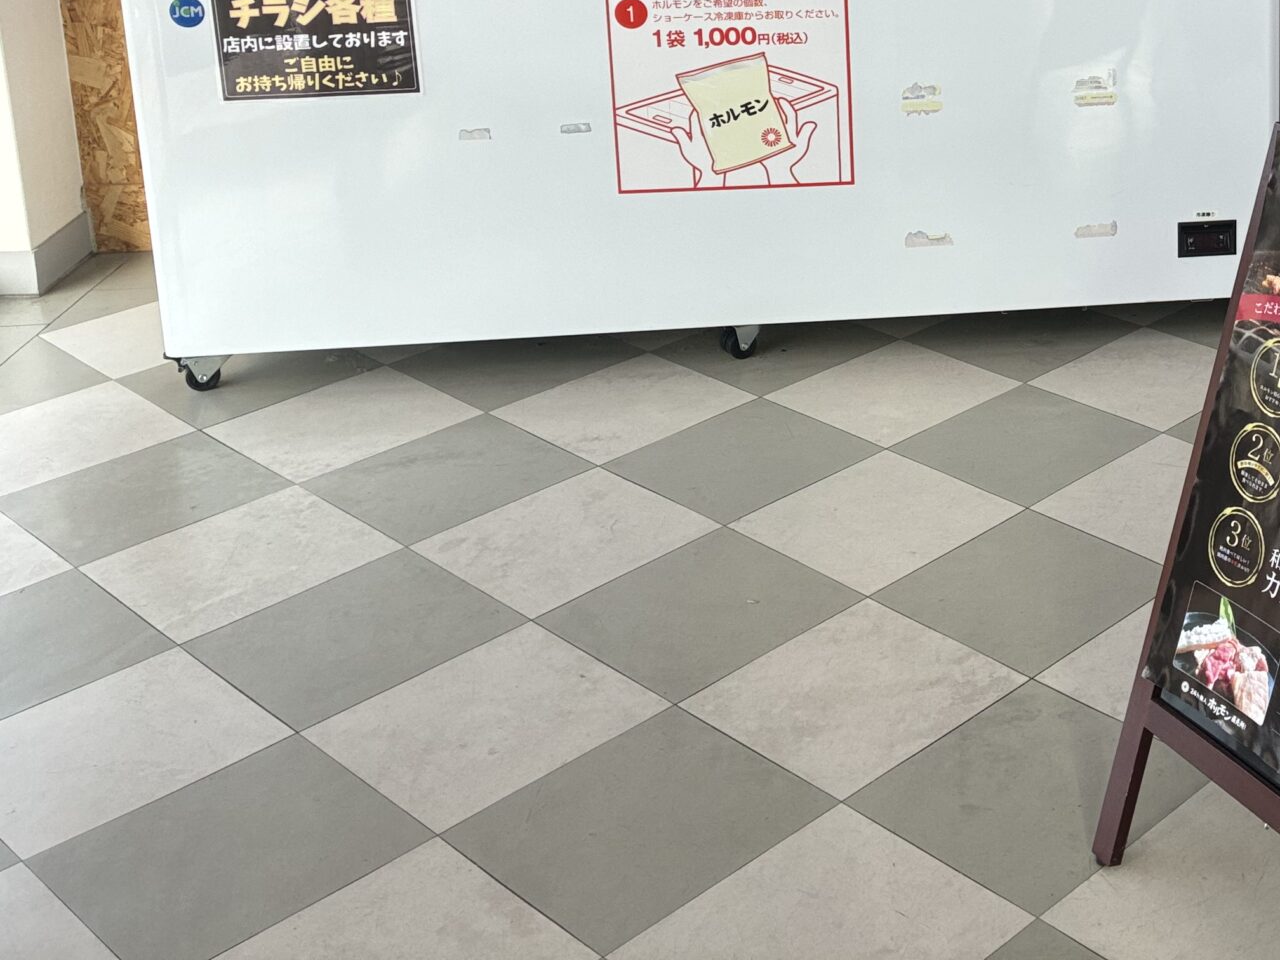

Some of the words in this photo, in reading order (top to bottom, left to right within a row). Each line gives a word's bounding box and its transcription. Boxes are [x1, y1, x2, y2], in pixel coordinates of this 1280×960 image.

[173, 0, 204, 18] JCM
[626, 6, 634, 23] 1
[653, 9, 840, 23] ショーケース冷凍庫からお取りください。
[223, 30, 409, 54] 店内に設置しております
[652, 29, 686, 48] 1袋
[283, 56, 355, 73] ご自由に
[709, 99, 769, 128] ホルモン
[1247, 433, 1274, 465] 2位
[1225, 519, 1254, 552] 3位
